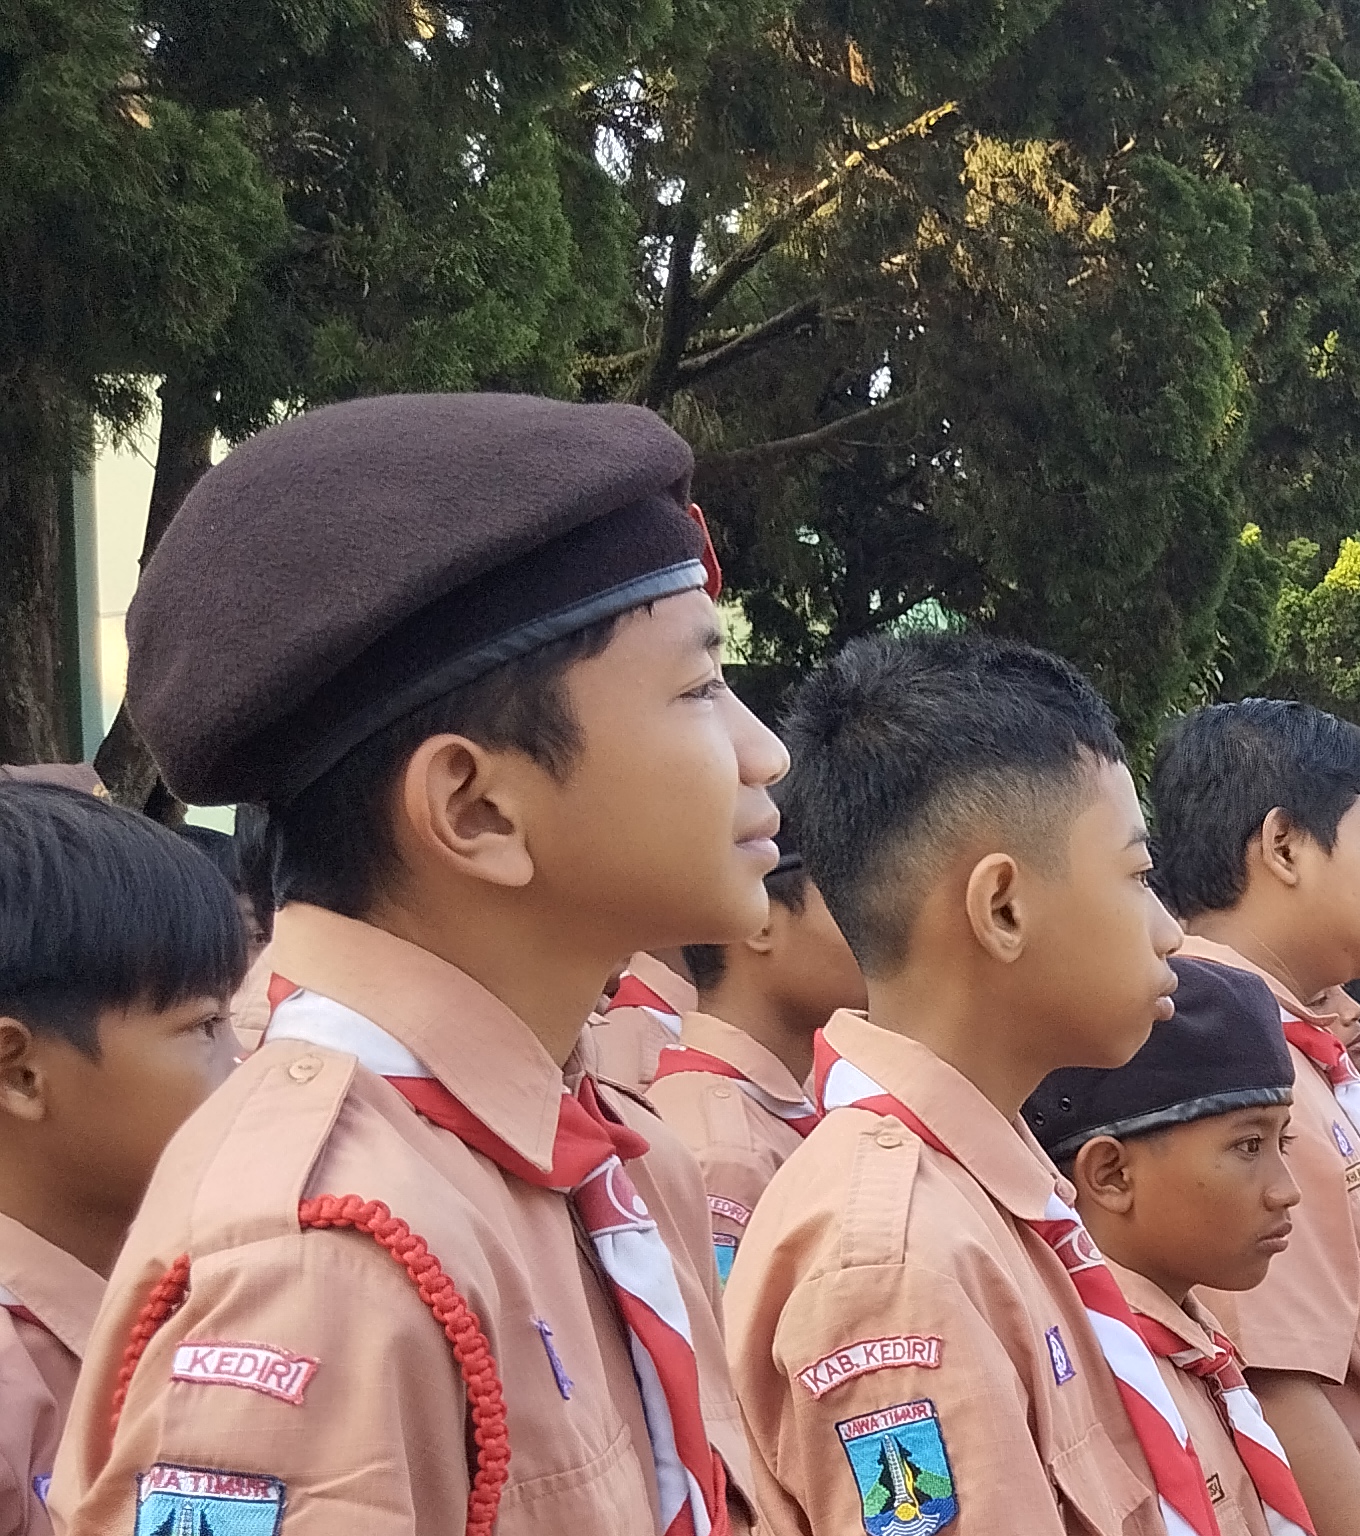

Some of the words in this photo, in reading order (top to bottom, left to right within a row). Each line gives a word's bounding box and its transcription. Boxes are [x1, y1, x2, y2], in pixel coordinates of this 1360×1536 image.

[188, 1348, 303, 1393] KEDIRI
[806, 1354, 861, 1393] KAB.
[863, 1340, 934, 1365] KEDIRI
[844, 1418, 880, 1438] JAWA
[881, 1404, 929, 1427] TIMUR
[190, 1473, 271, 1499] TIMUR
